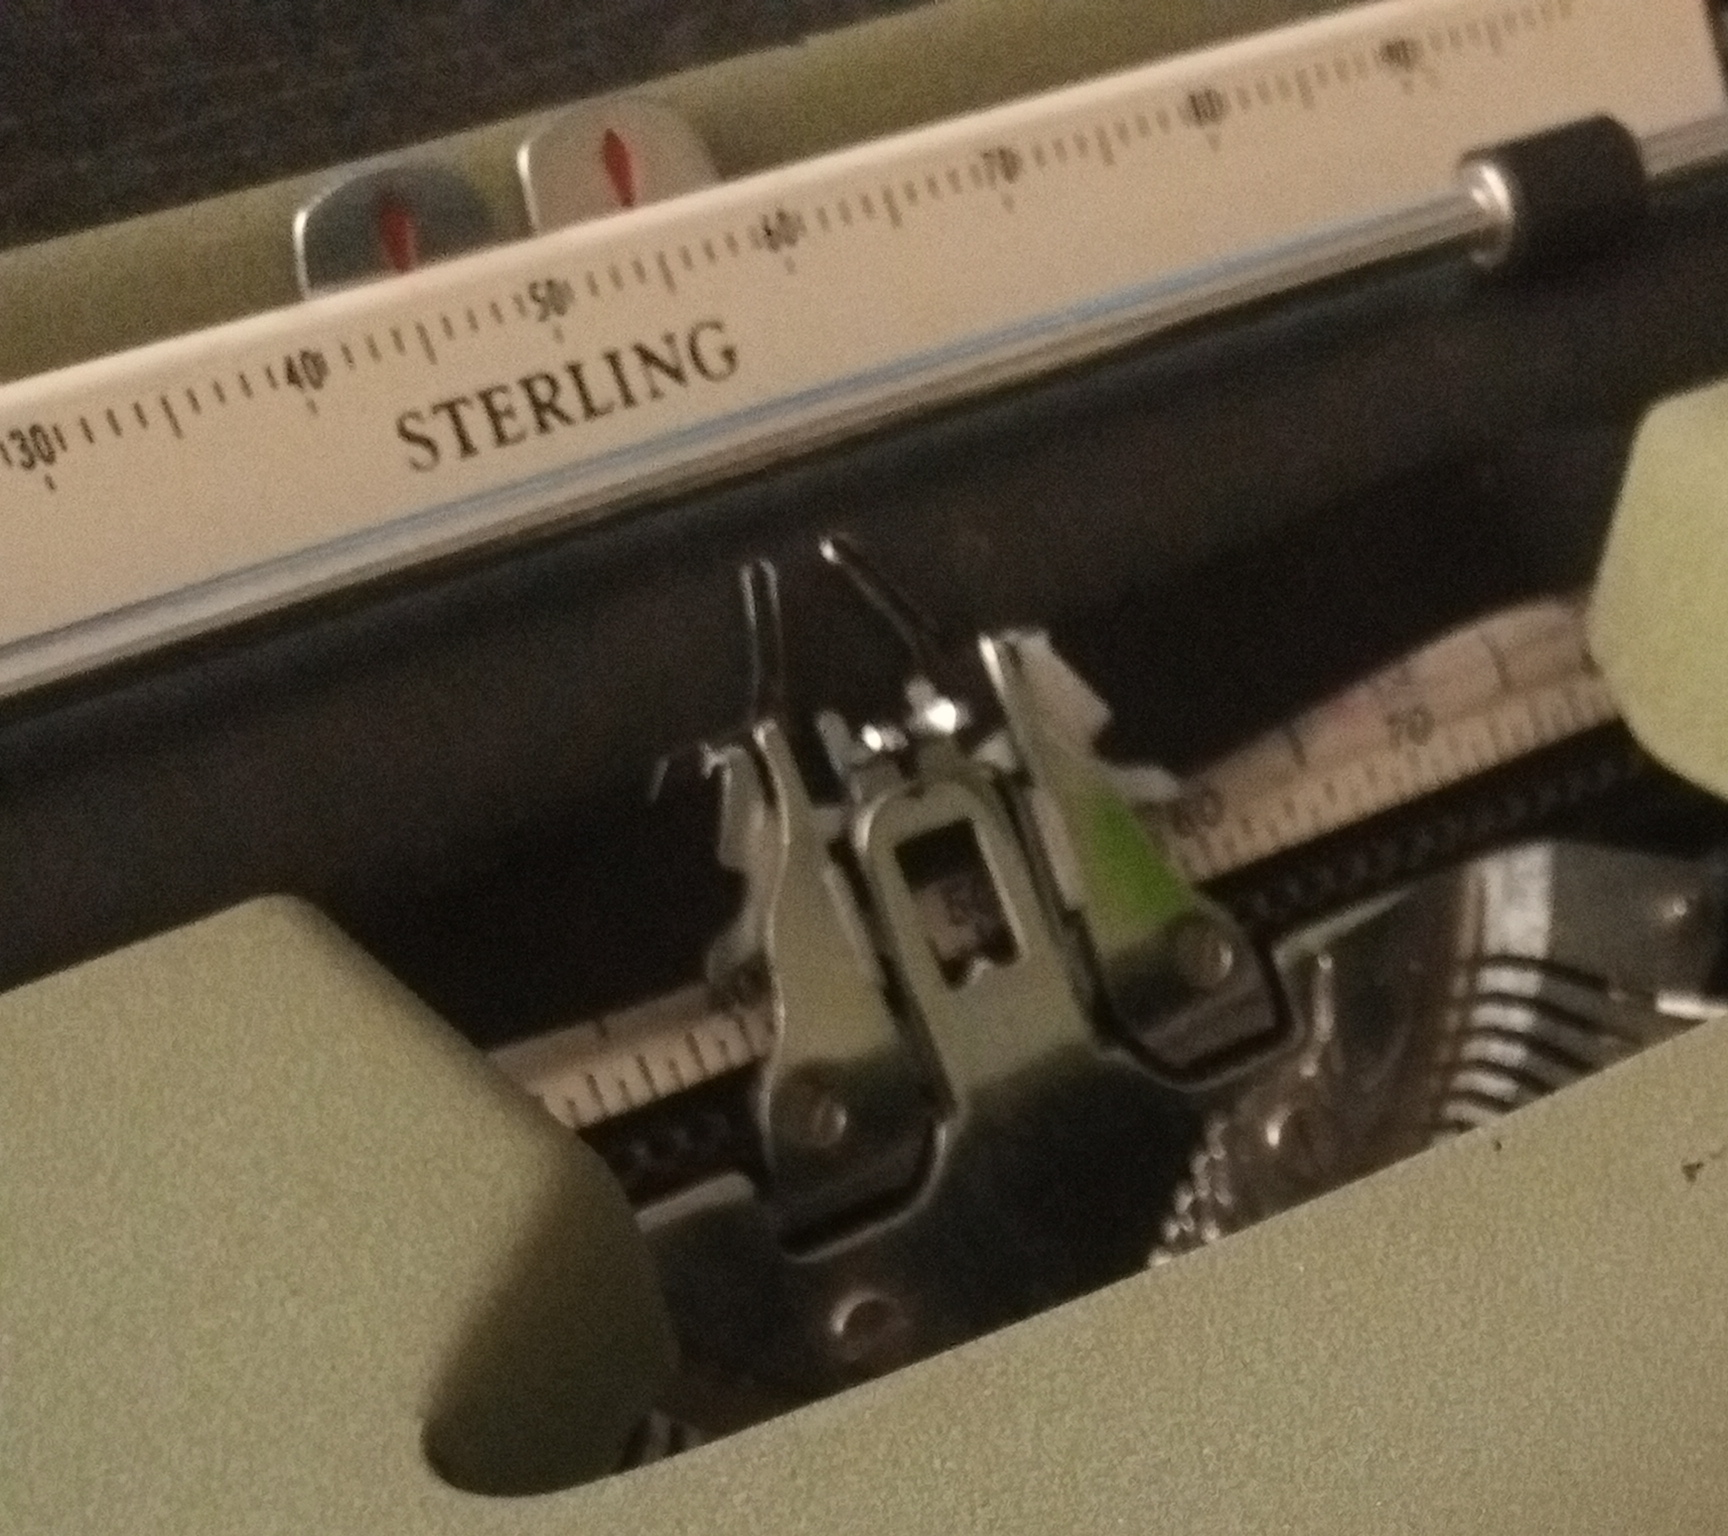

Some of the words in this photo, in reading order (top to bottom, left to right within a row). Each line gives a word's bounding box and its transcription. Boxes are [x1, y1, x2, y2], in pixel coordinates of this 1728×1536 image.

[8, 424, 56, 469] 30
[284, 350, 329, 391] 40
[529, 279, 574, 322] 50
[397, 320, 740, 473] STERLING
